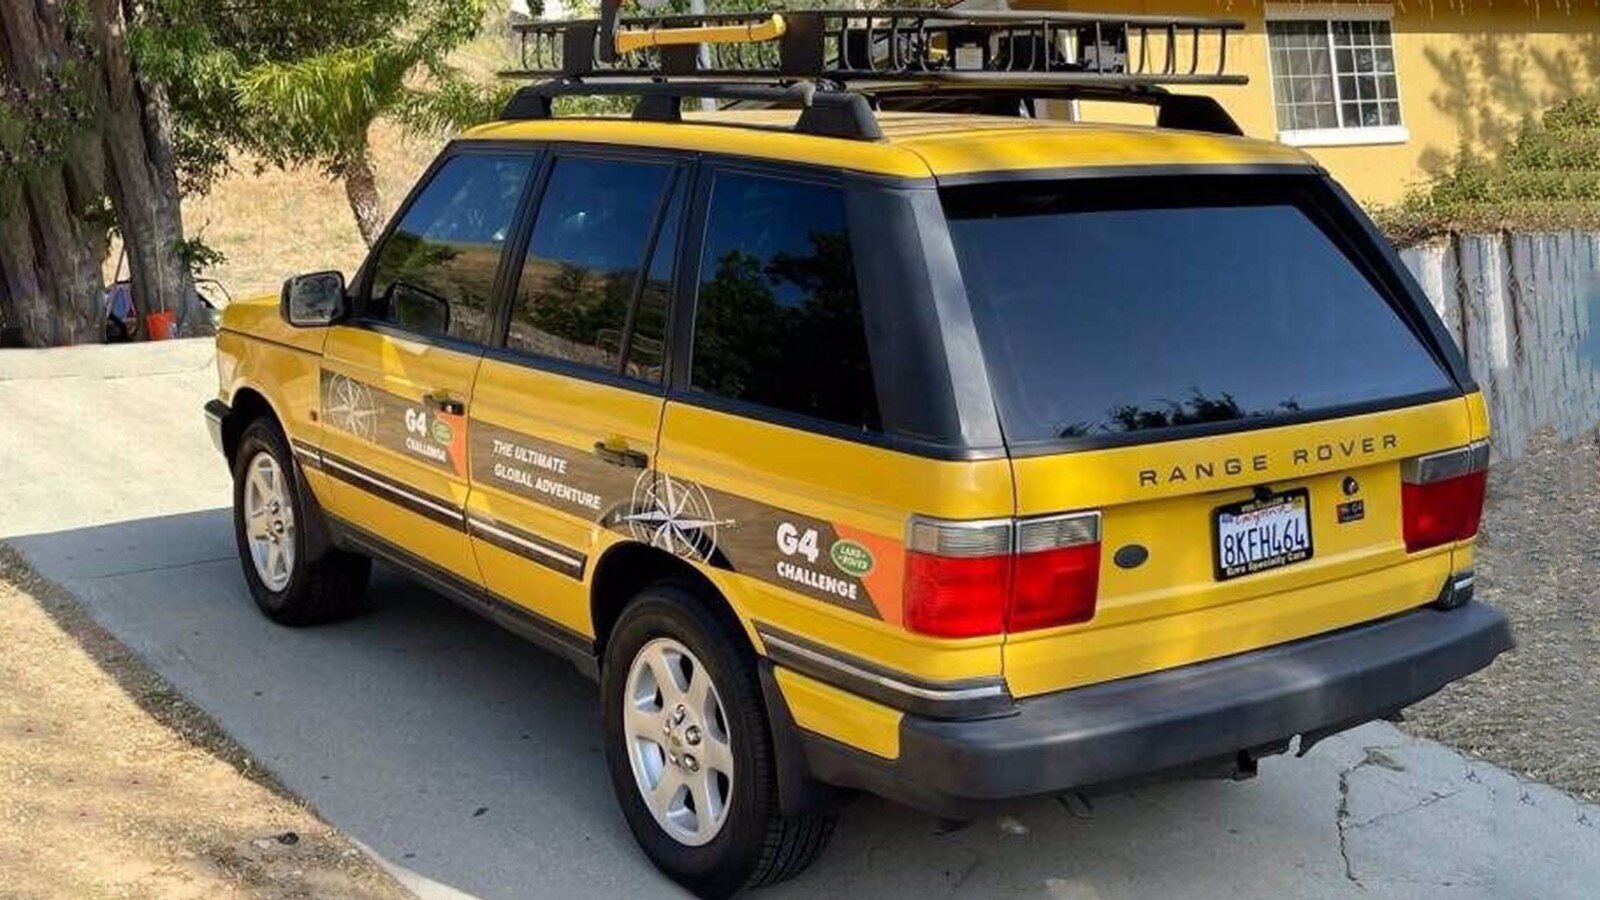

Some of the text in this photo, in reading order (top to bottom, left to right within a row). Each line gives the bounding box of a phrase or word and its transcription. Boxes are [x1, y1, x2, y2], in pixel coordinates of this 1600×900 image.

[405, 408, 427, 437] G4
[493, 439, 568, 474] THE ULTIMATE
[1138, 434, 1398, 487] RANGE ROVER
[494, 463, 602, 510] GLOBAL ADVENTURE
[776, 522, 819, 563] G4
[1223, 518, 1306, 565] 8KFH464
[776, 561, 858, 600] CHALLENGE
